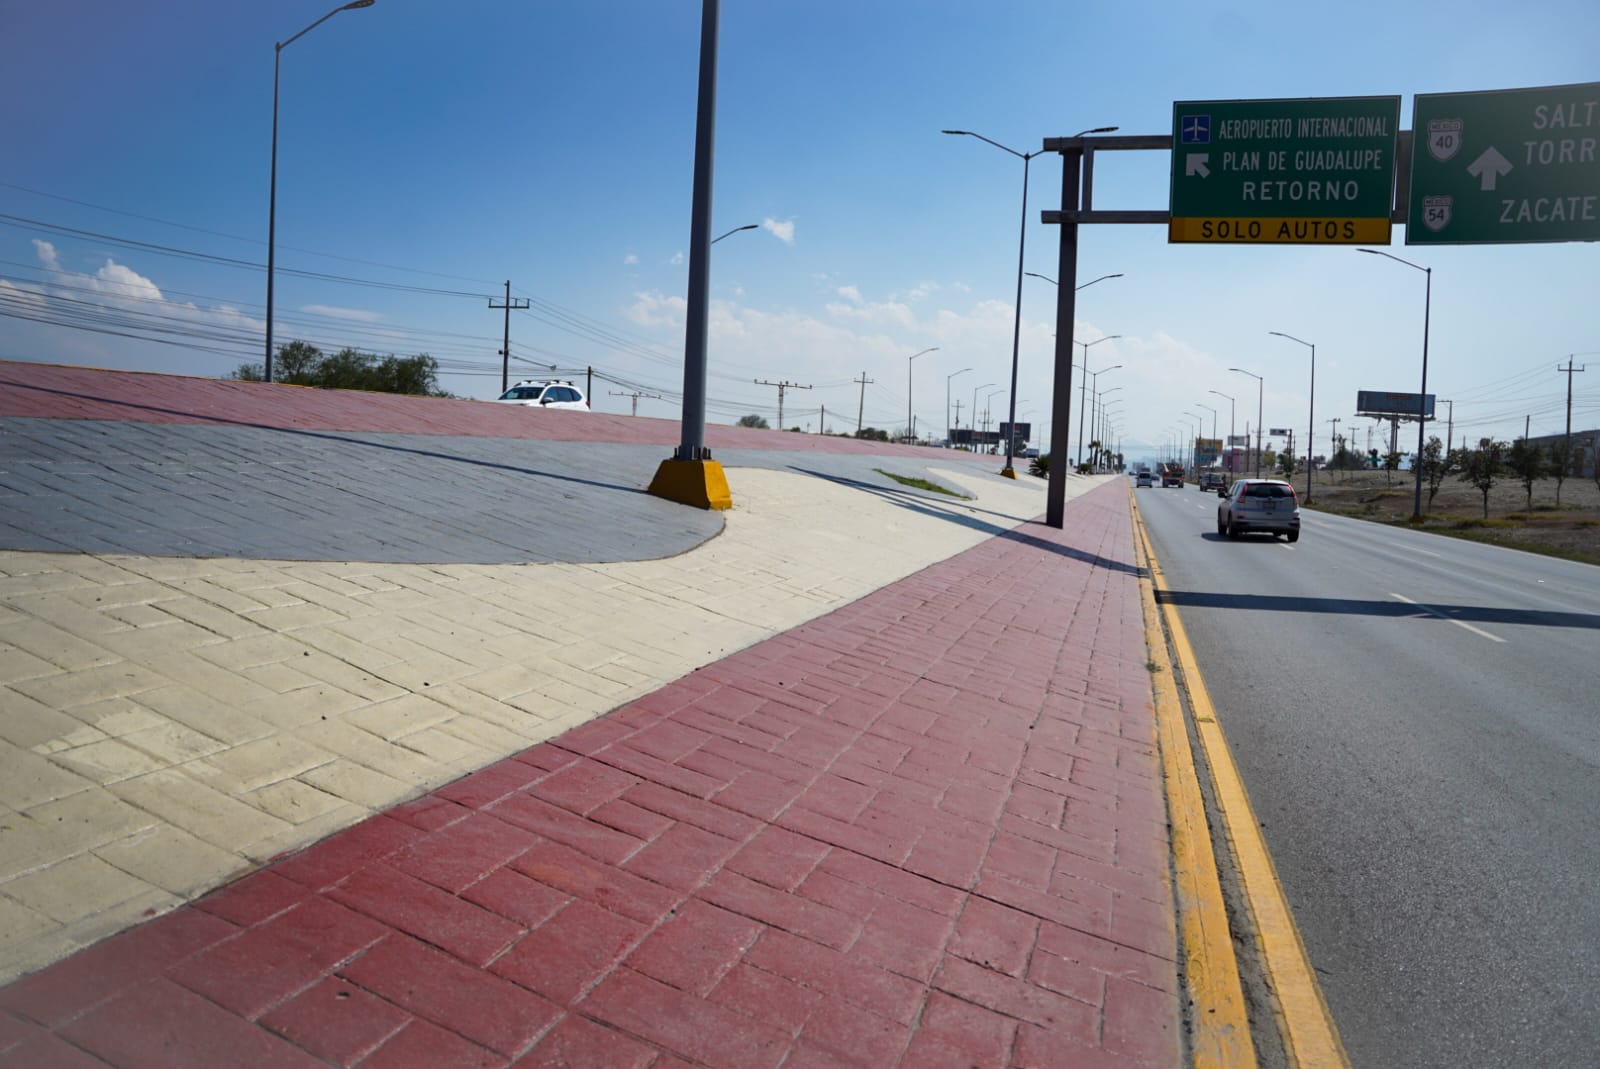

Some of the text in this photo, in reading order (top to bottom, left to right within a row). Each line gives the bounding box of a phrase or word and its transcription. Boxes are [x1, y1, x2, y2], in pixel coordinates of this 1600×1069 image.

[1532, 101, 1600, 130] SALT
[1219, 116, 1388, 139] AEROPUERTO INTERNACIONAL
[1435, 135, 1453, 149] 40
[1523, 138, 1596, 165] TORR
[1223, 149, 1382, 171] PLAN DE GUADALUPE
[1242, 180, 1359, 201] RETORNO
[1428, 209, 1444, 222] 54
[1500, 196, 1597, 223] ZACATE
[1202, 220, 1355, 240] SOLO AUTOS
